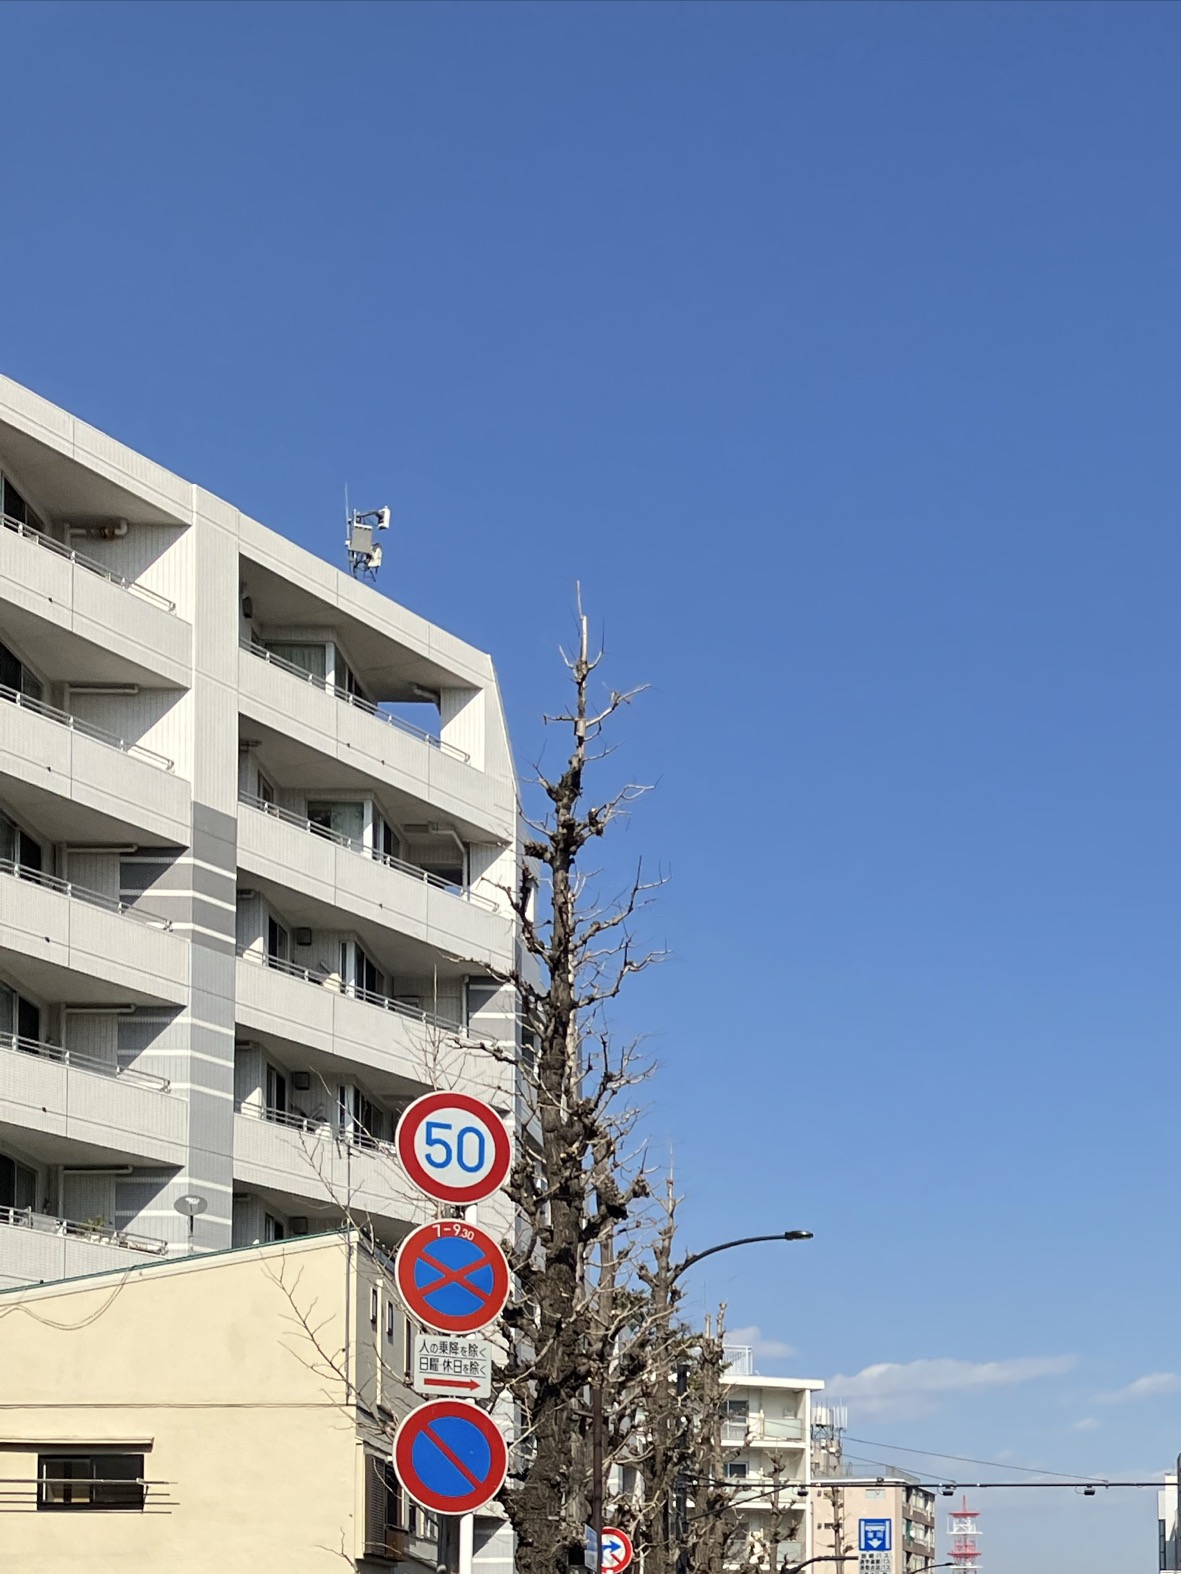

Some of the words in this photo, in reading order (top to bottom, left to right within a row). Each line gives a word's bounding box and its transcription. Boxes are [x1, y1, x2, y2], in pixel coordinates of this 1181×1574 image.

[425, 1121, 485, 1173] 50
[419, 1339, 487, 1358] 人の乗降を除く
